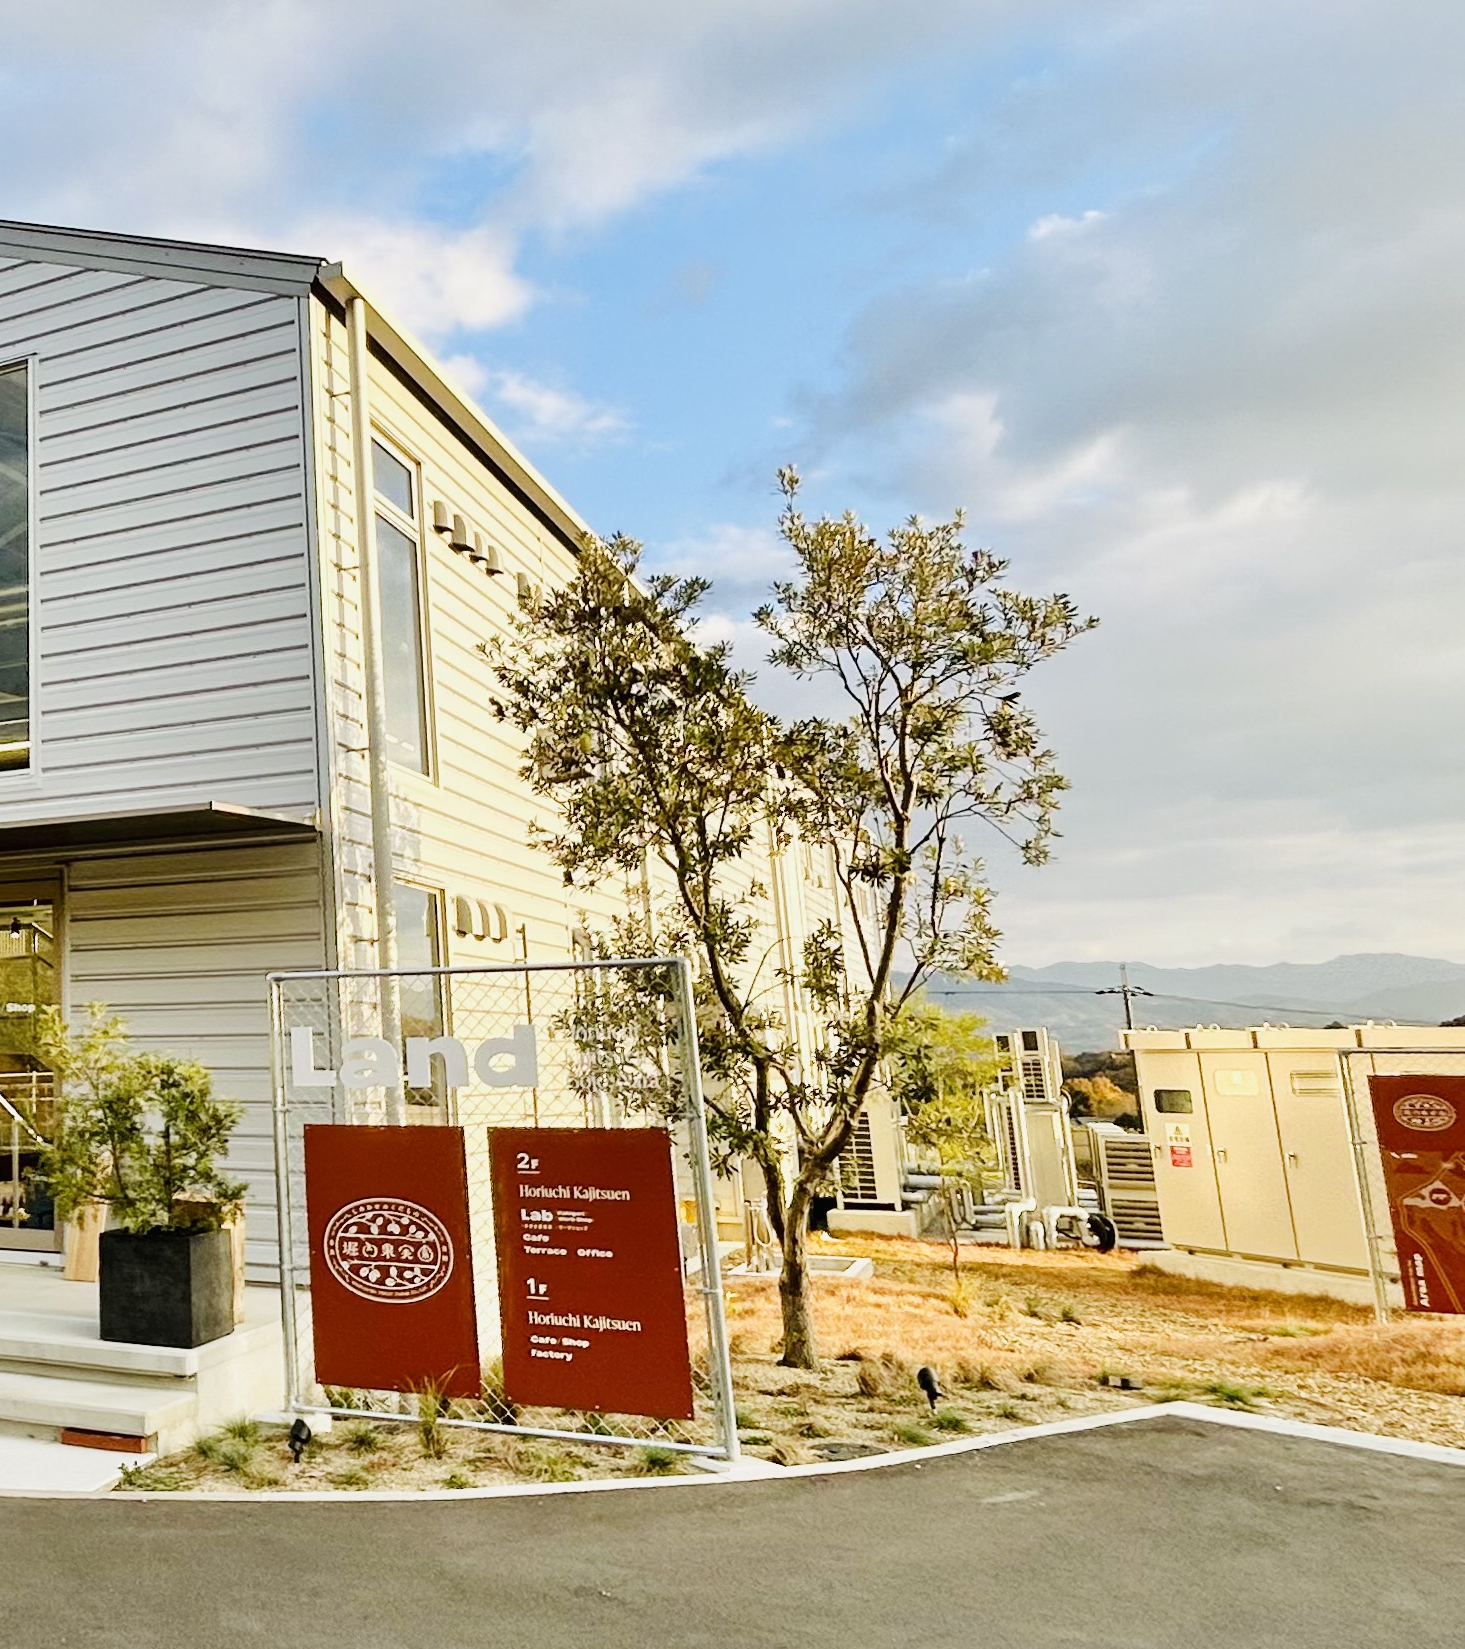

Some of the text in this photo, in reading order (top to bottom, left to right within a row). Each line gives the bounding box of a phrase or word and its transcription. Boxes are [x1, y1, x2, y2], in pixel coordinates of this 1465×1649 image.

[290, 1024, 538, 1088] Land
[517, 1152, 539, 1170] 2F
[519, 1184, 631, 1202] Horiuchi Kajitsuen
[520, 1208, 554, 1222] Lab
[523, 1245, 614, 1258] Terrace Office
[526, 1277, 548, 1295] 1F
[527, 1310, 642, 1333] Horiuchi Kajitsuen
[530, 1348, 573, 1362] Factory
